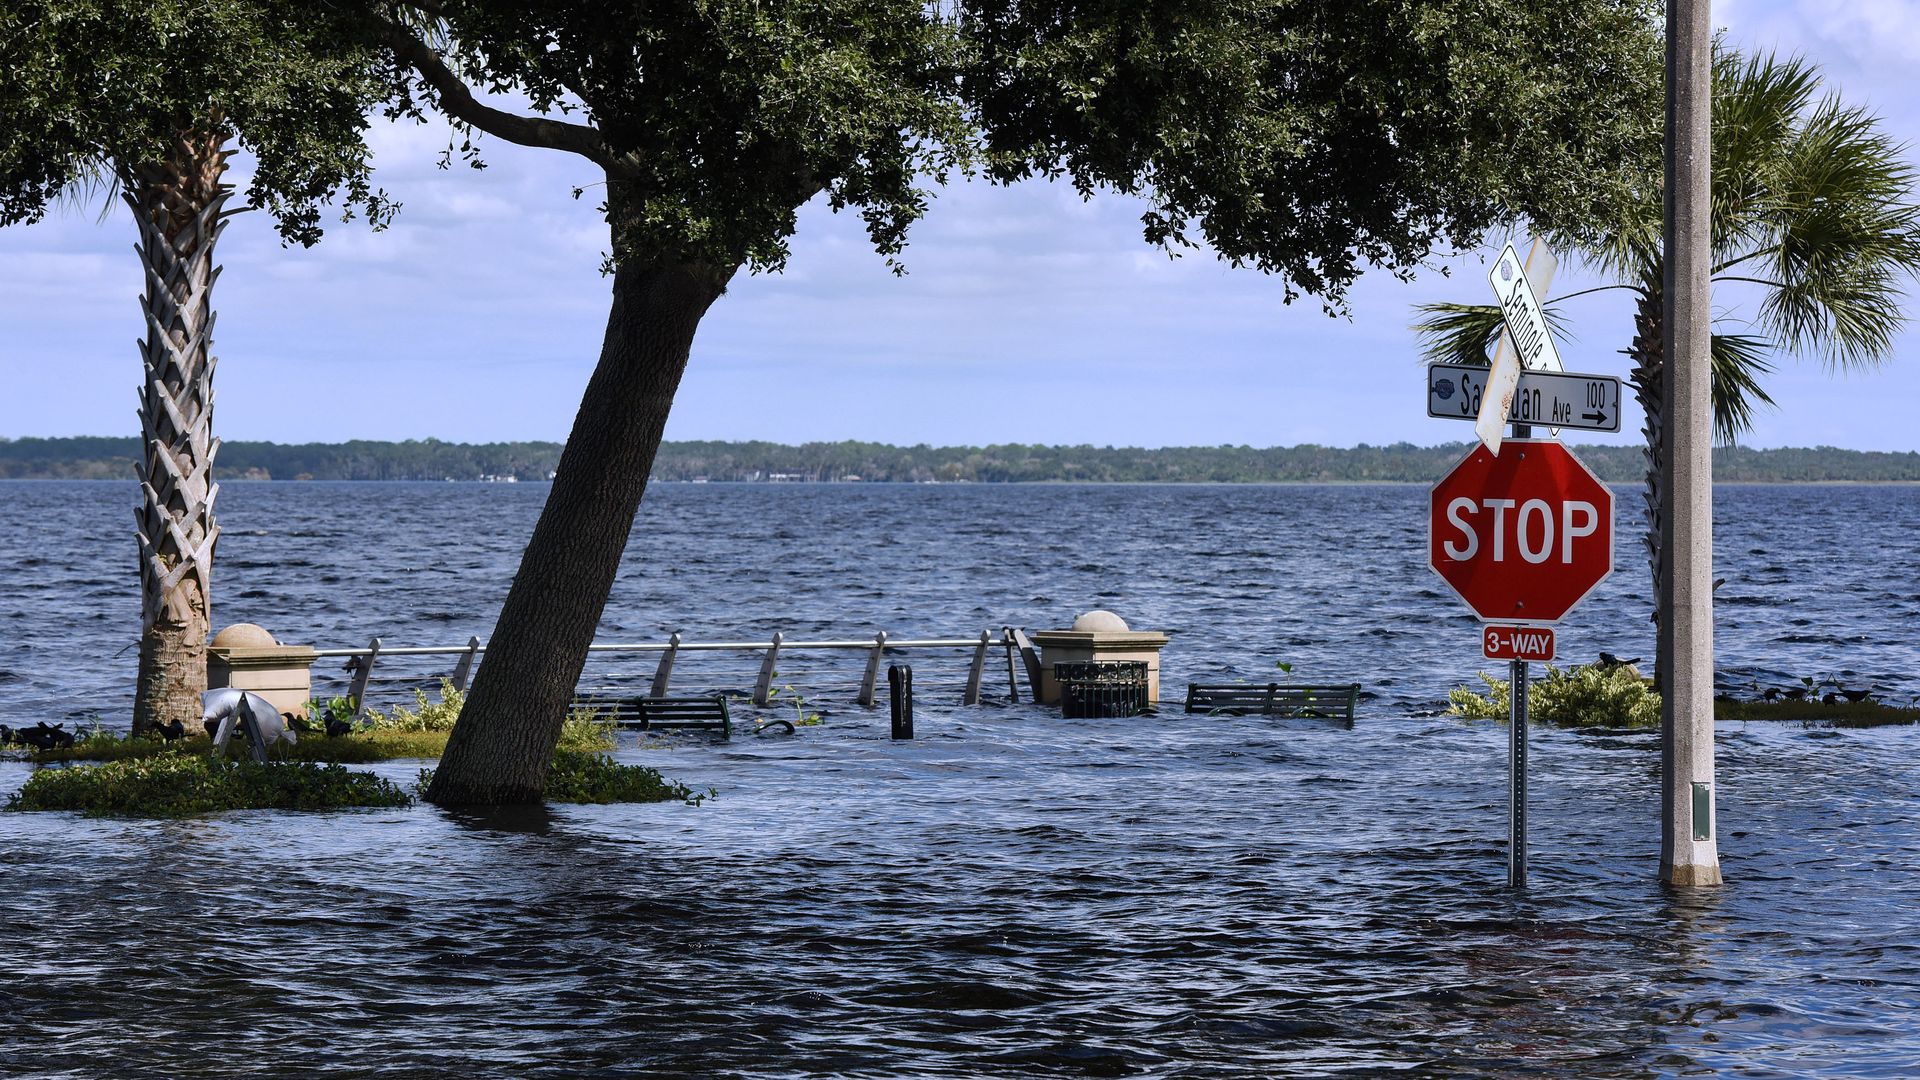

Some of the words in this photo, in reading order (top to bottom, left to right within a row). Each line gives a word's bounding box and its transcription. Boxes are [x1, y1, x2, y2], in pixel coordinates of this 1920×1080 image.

[1504, 277, 1544, 366] Seminole
[1552, 396, 1571, 424] Ave
[1586, 381, 1606, 410] 100
[1443, 496, 1599, 565] STOP
[1487, 631, 1551, 656] 3-WAY
